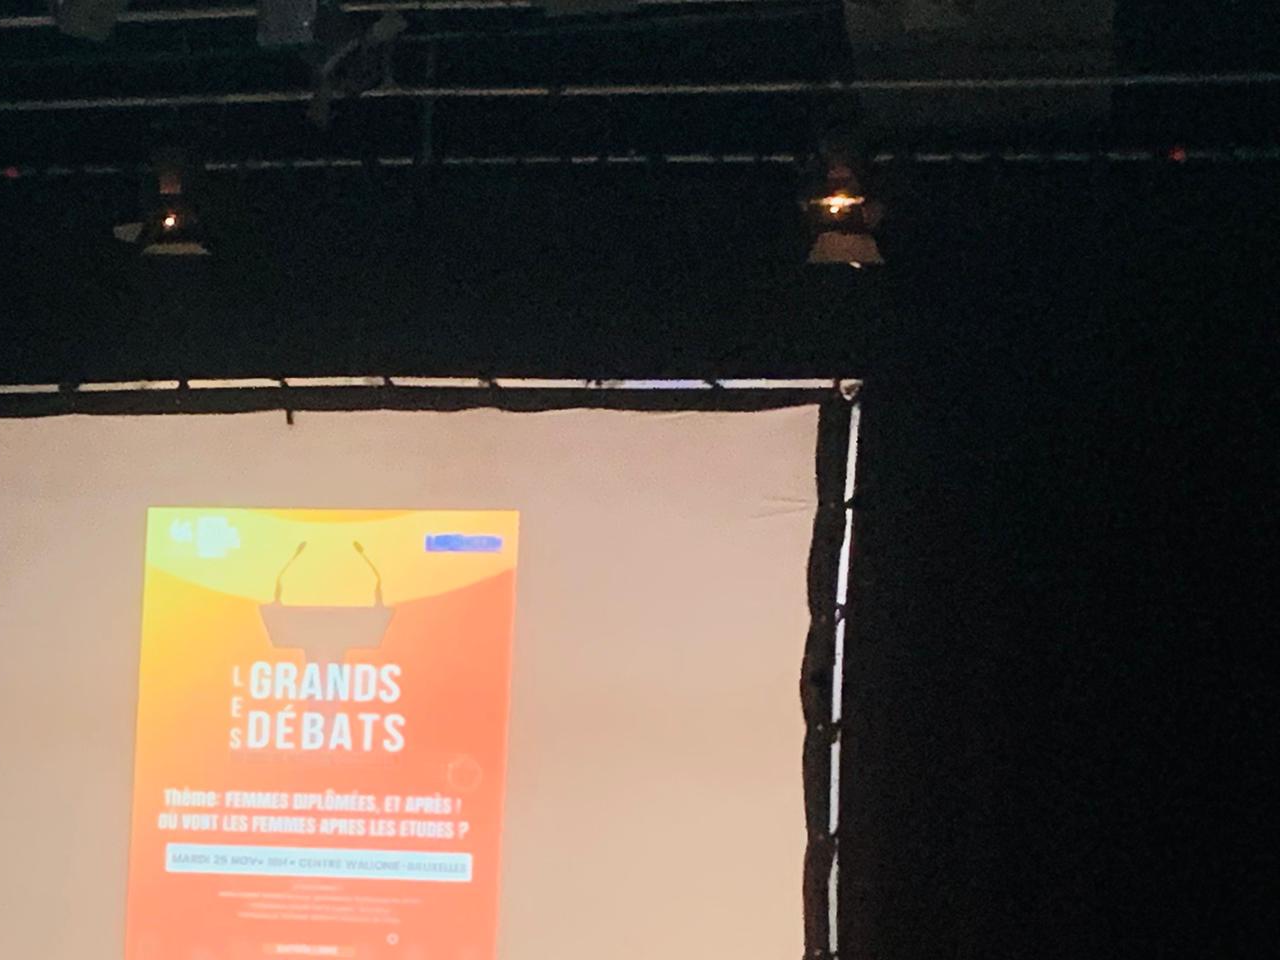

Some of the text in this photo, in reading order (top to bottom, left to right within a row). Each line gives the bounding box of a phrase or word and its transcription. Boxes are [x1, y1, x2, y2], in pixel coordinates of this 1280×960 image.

[249, 660, 402, 703] GRANDS
[247, 704, 406, 752] DÉBATS
[225, 791, 288, 809] FEMMES
[292, 788, 380, 814] DIPLÔMÉES,
[384, 795, 401, 814] ET
[405, 792, 452, 815] APRÈS
[181, 813, 218, 831] VONT
[223, 815, 249, 832] LES
[252, 816, 317, 834] FEMMES
[369, 818, 397, 837] LES
[458, 821, 470, 839] ?
